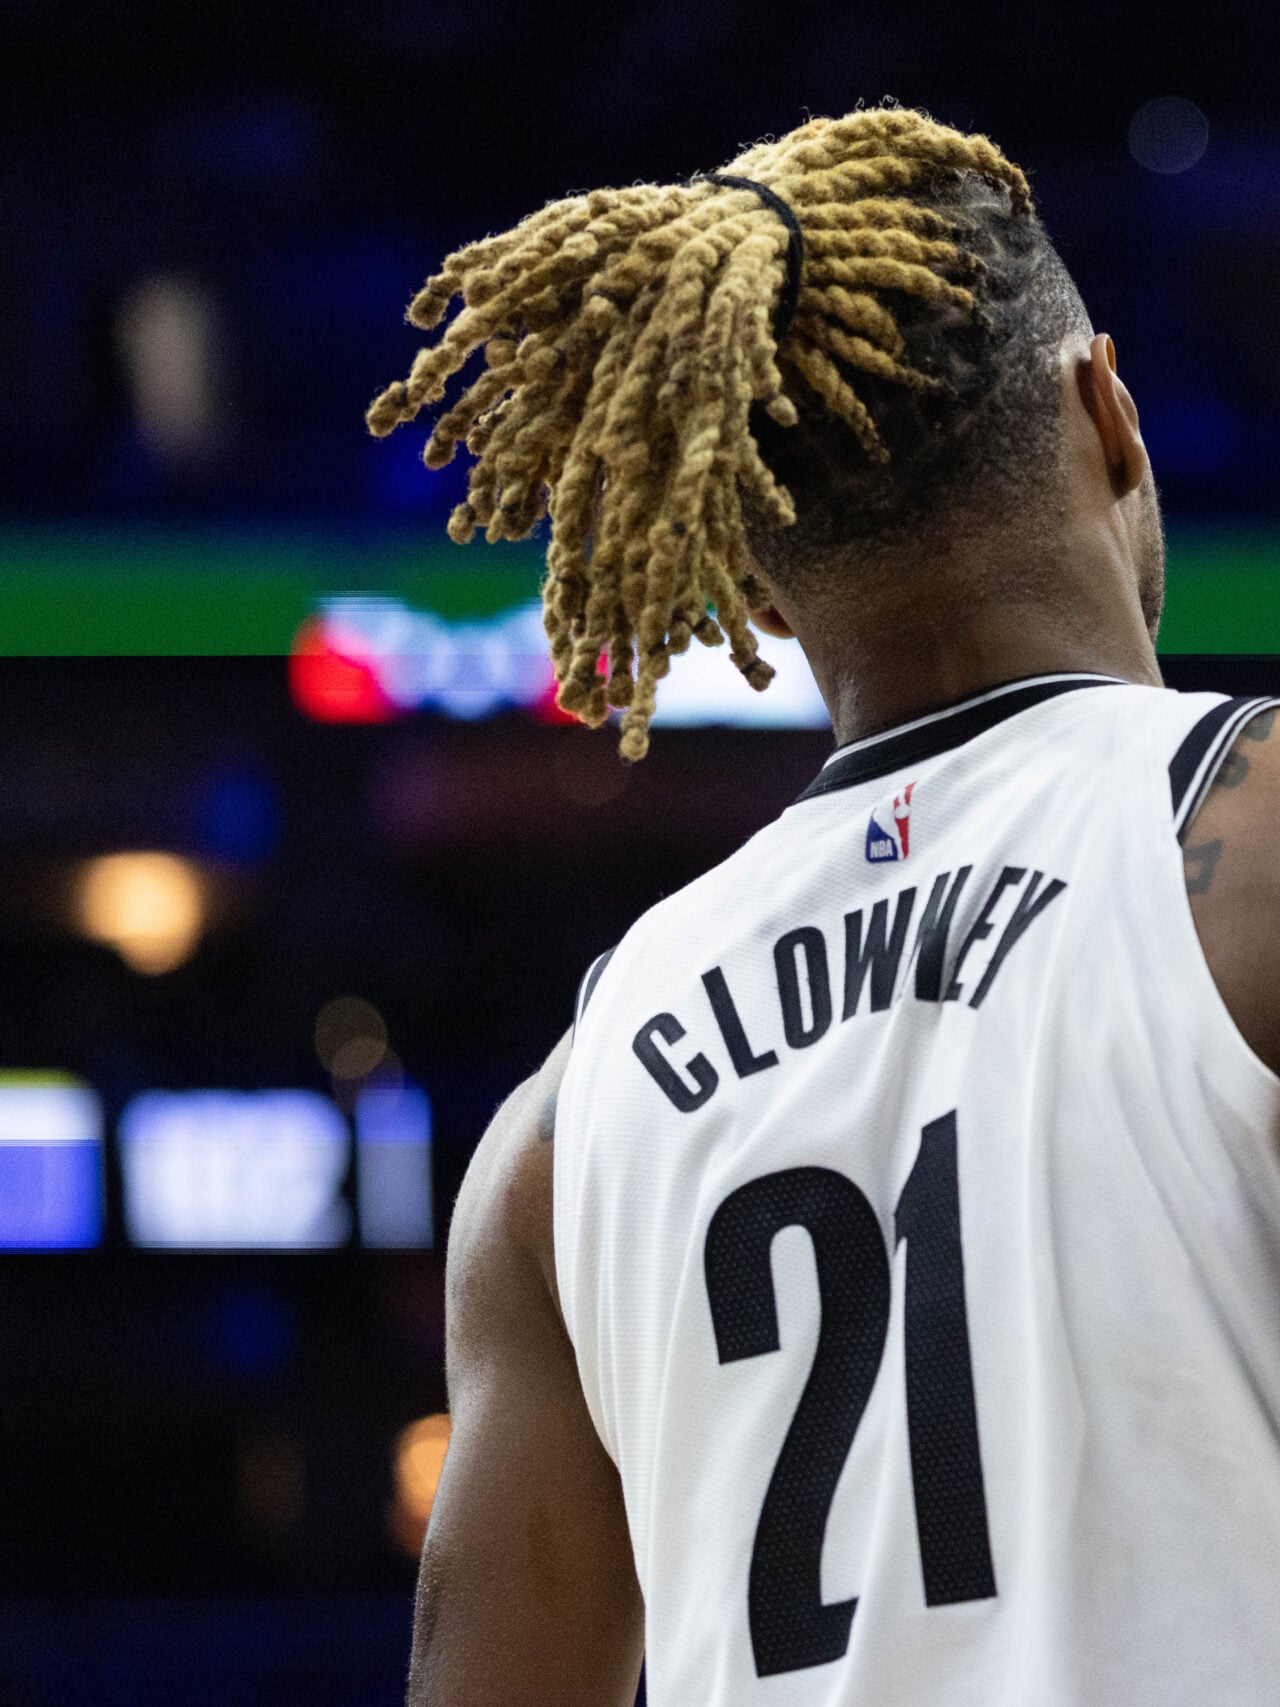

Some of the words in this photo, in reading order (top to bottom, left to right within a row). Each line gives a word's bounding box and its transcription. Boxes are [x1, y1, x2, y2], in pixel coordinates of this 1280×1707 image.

[870, 838, 894, 859] NBA
[632, 864, 1068, 1113] CLOWNEY
[703, 1107, 998, 1678] 21
